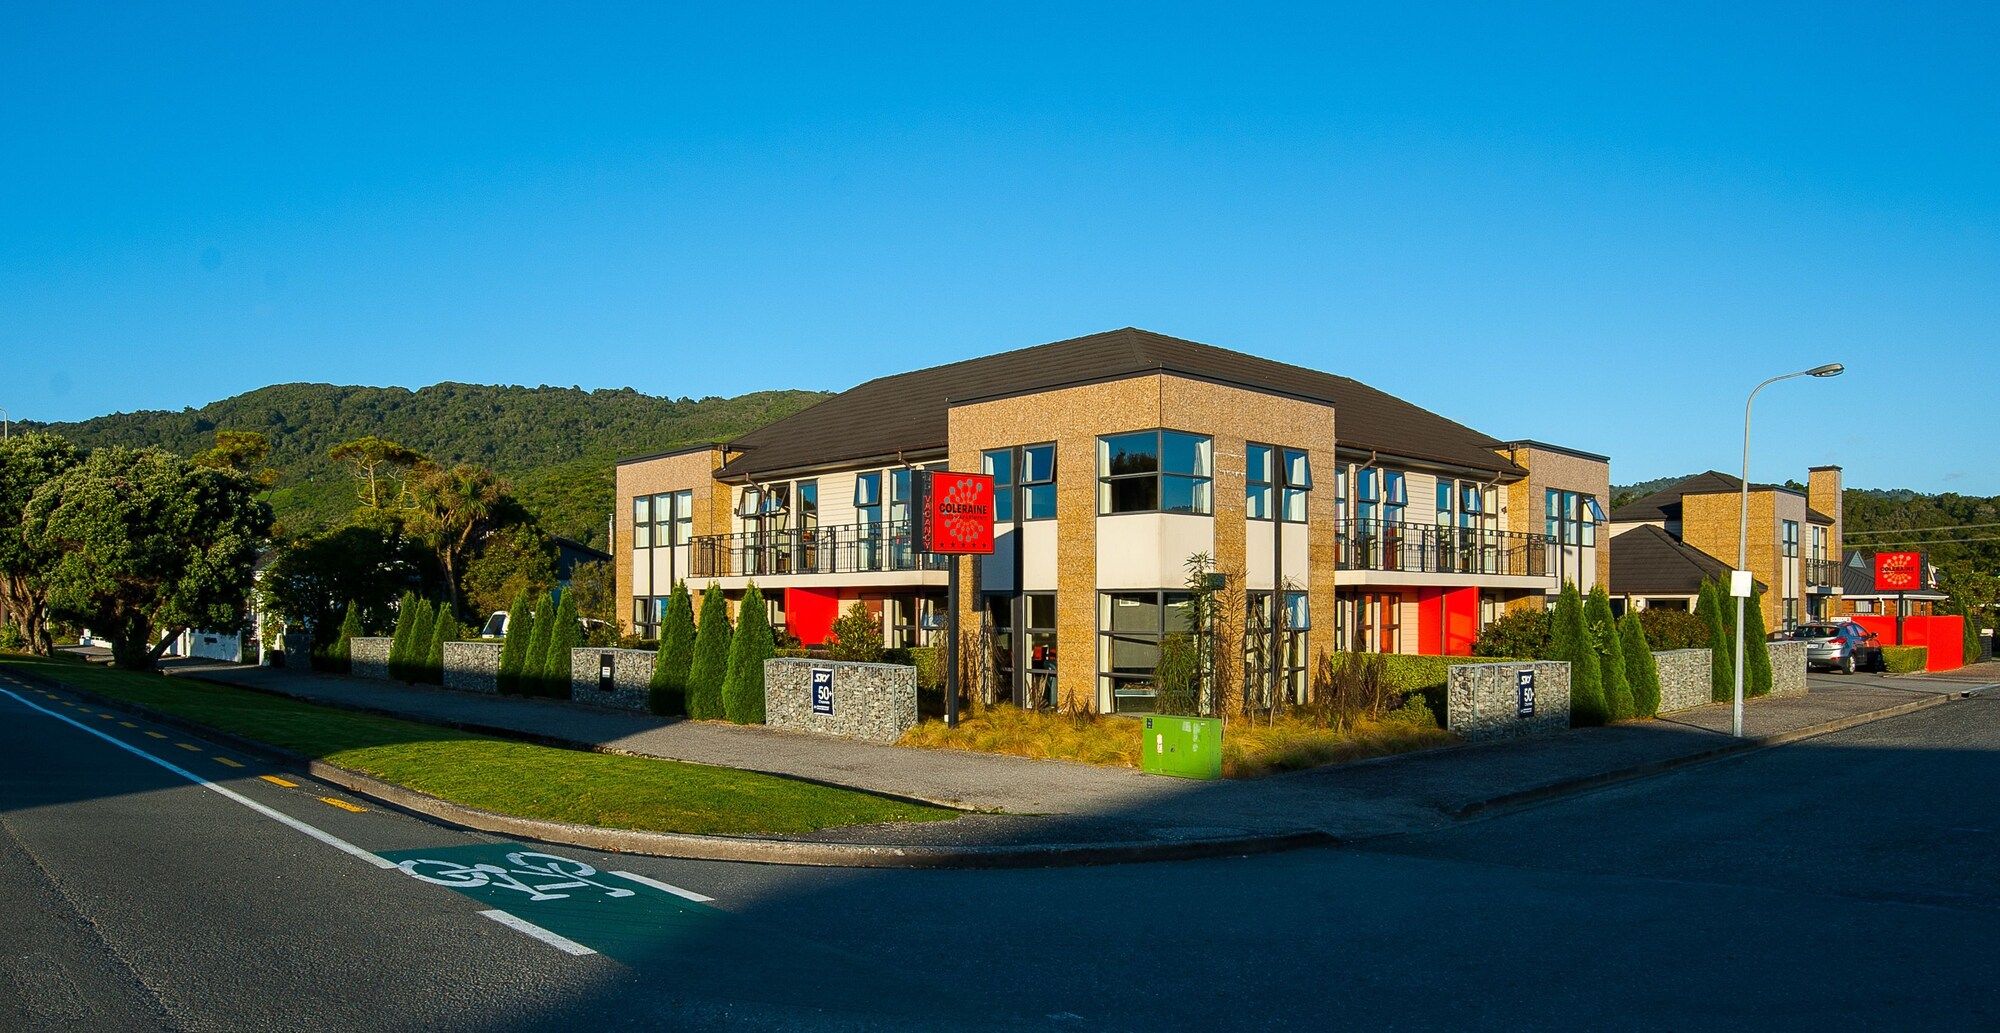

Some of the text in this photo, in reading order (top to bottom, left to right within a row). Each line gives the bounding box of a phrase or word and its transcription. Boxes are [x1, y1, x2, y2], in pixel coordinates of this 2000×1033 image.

[939, 503, 987, 514] COLERAINE
[923, 495, 931, 549] VACANCY
[818, 686, 832, 700] 50+
